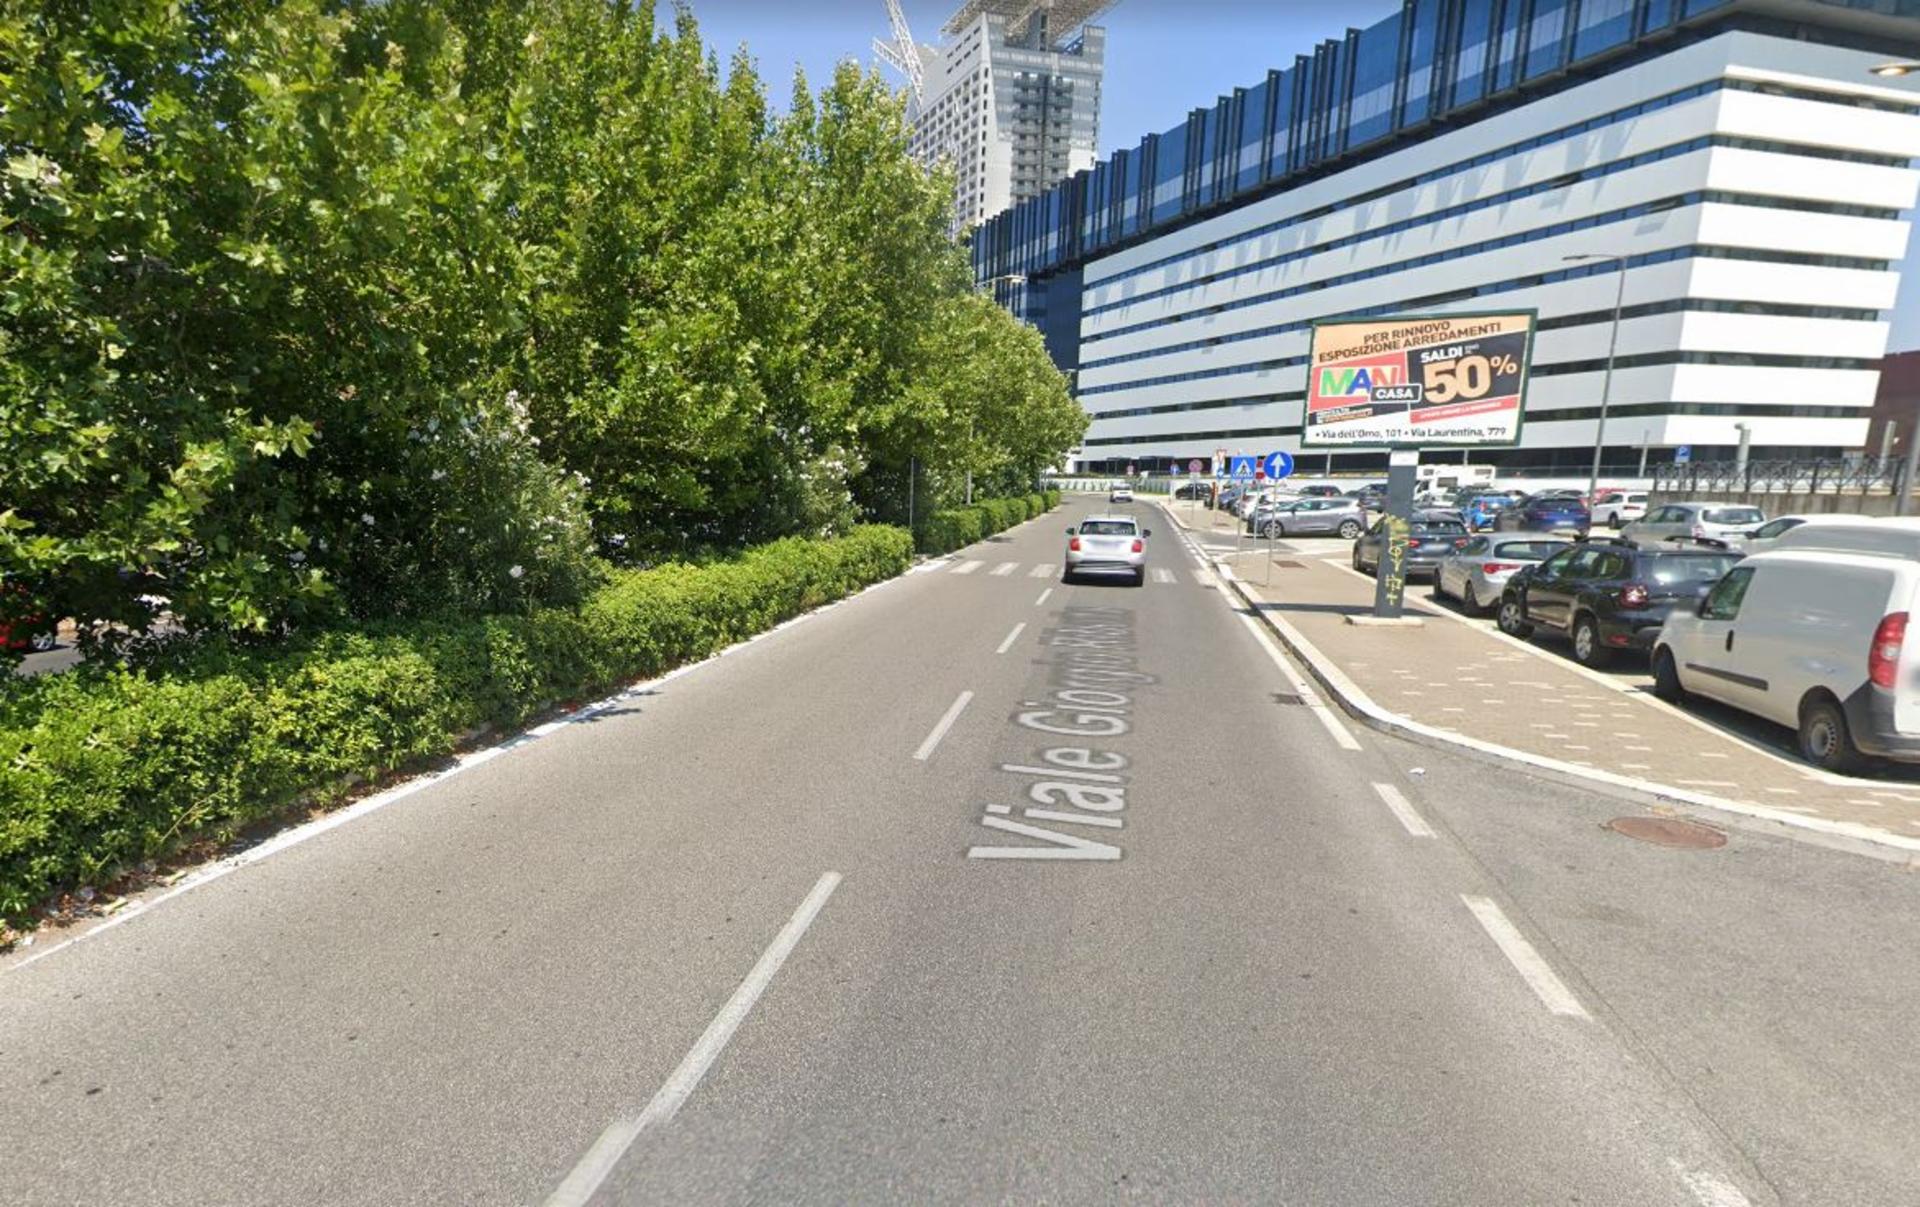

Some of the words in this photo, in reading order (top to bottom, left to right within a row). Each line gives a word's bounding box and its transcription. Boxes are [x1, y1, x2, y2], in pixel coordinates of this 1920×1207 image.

[1319, 341, 1401, 362] ESPOSIZIONE
[1403, 322, 1502, 349] ARREDAMENTI
[1363, 331, 1390, 345] PER
[1391, 321, 1451, 339] RINNOVO
[1421, 345, 1463, 363] SALDI
[1423, 353, 1518, 404] 50%
[1376, 388, 1414, 400] CASA
[1322, 429, 1336, 438] Via
[1385, 428, 1402, 437] 101
[1411, 427, 1426, 437] Via
